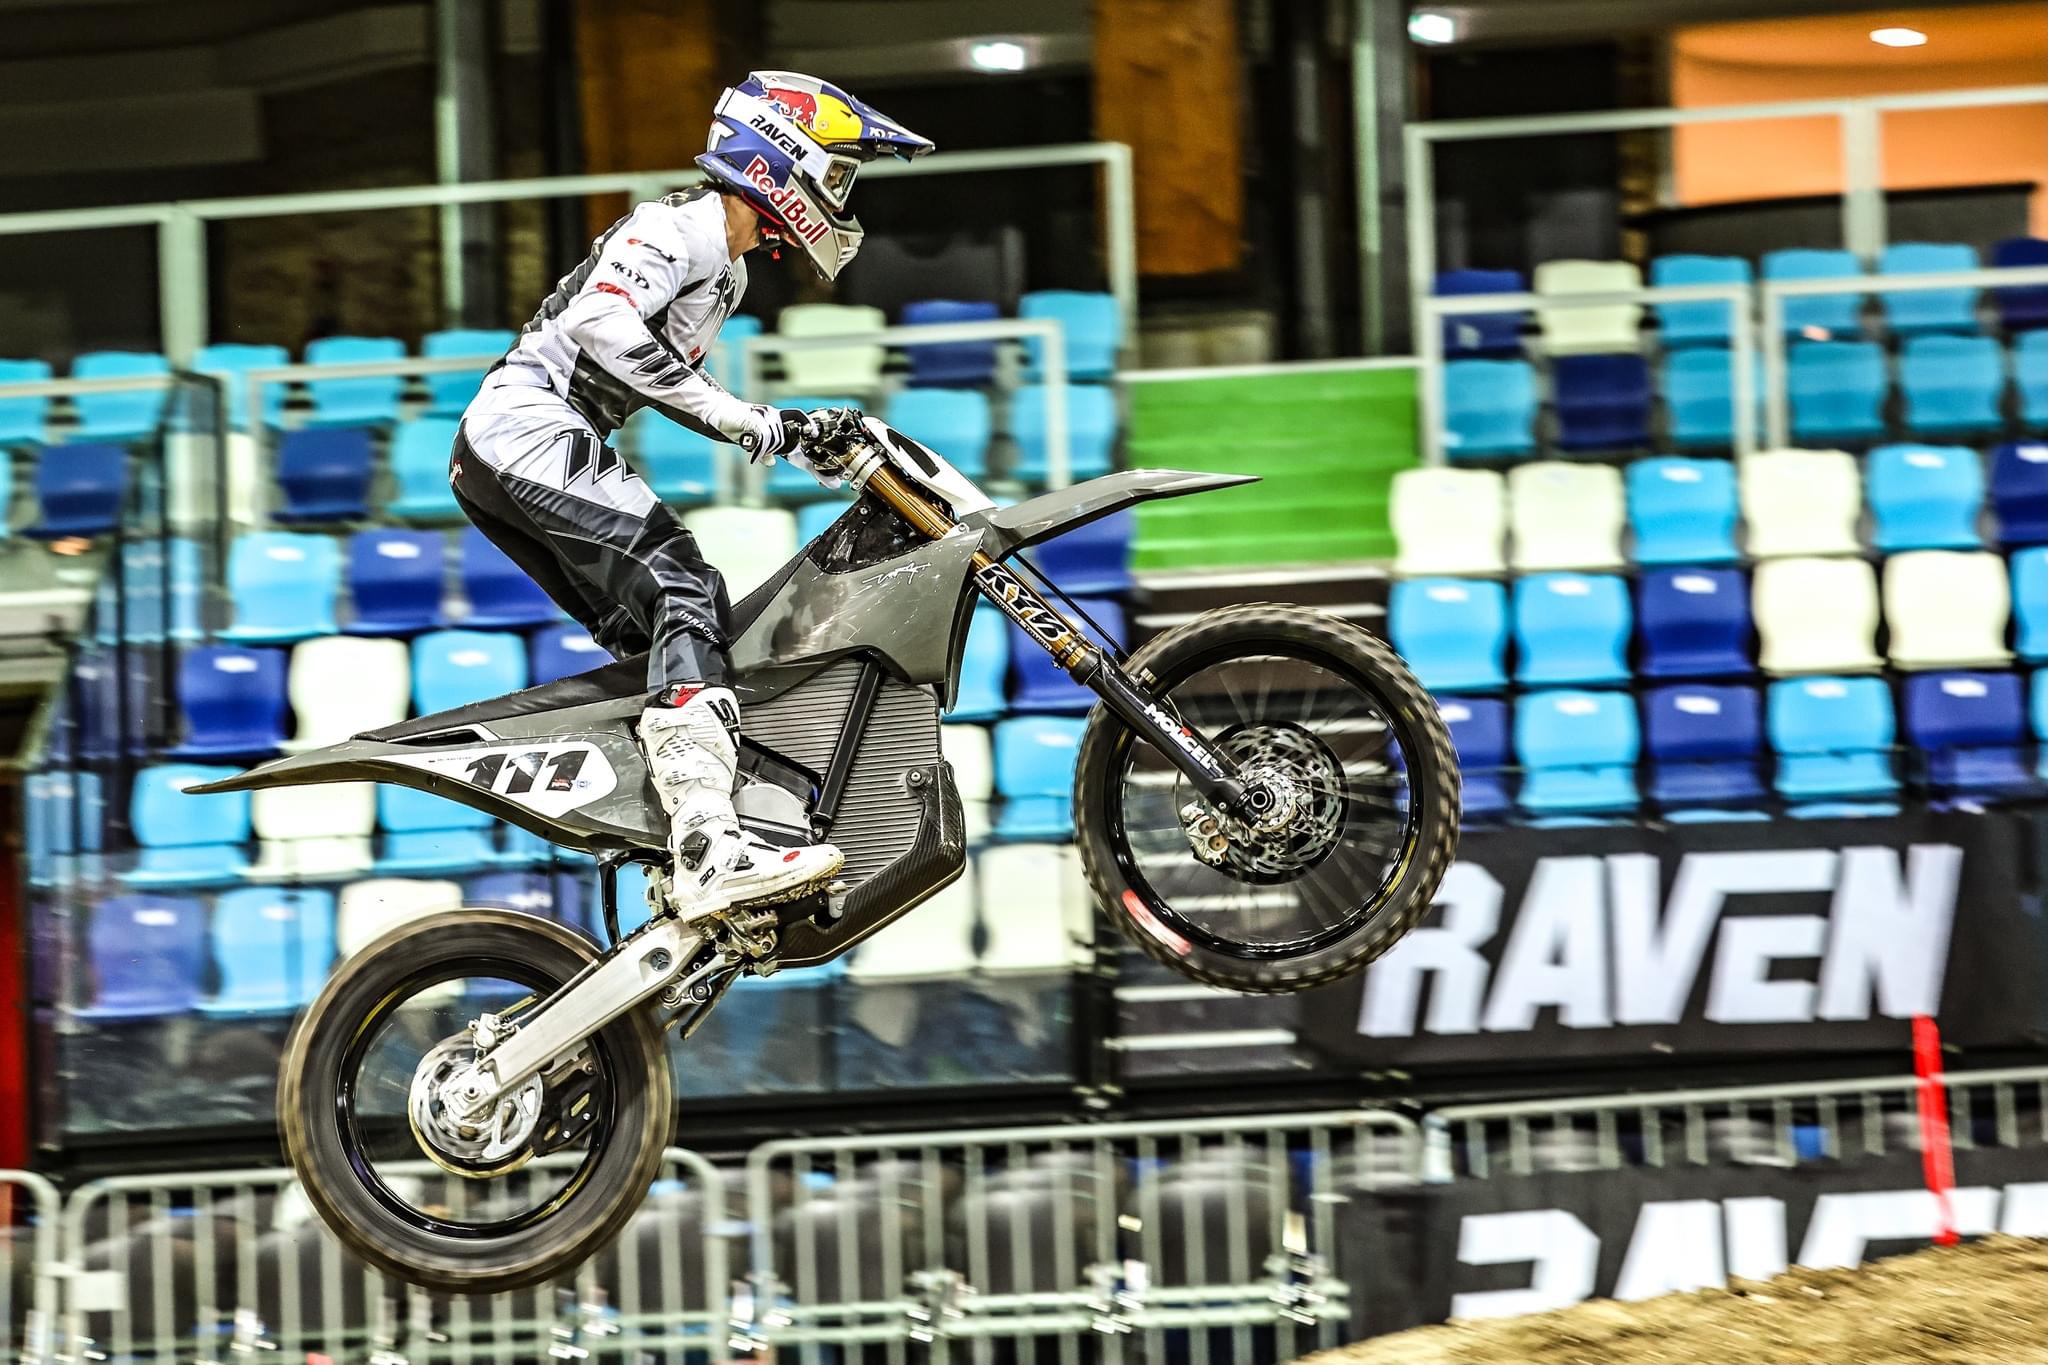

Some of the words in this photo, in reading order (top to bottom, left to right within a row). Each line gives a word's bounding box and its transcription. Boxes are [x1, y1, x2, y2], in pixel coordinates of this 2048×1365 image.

[750, 114, 808, 162] RAVEN
[977, 563, 1070, 642] KYB
[465, 750, 589, 794] 111
[1358, 843, 1964, 1037] RAVEN
